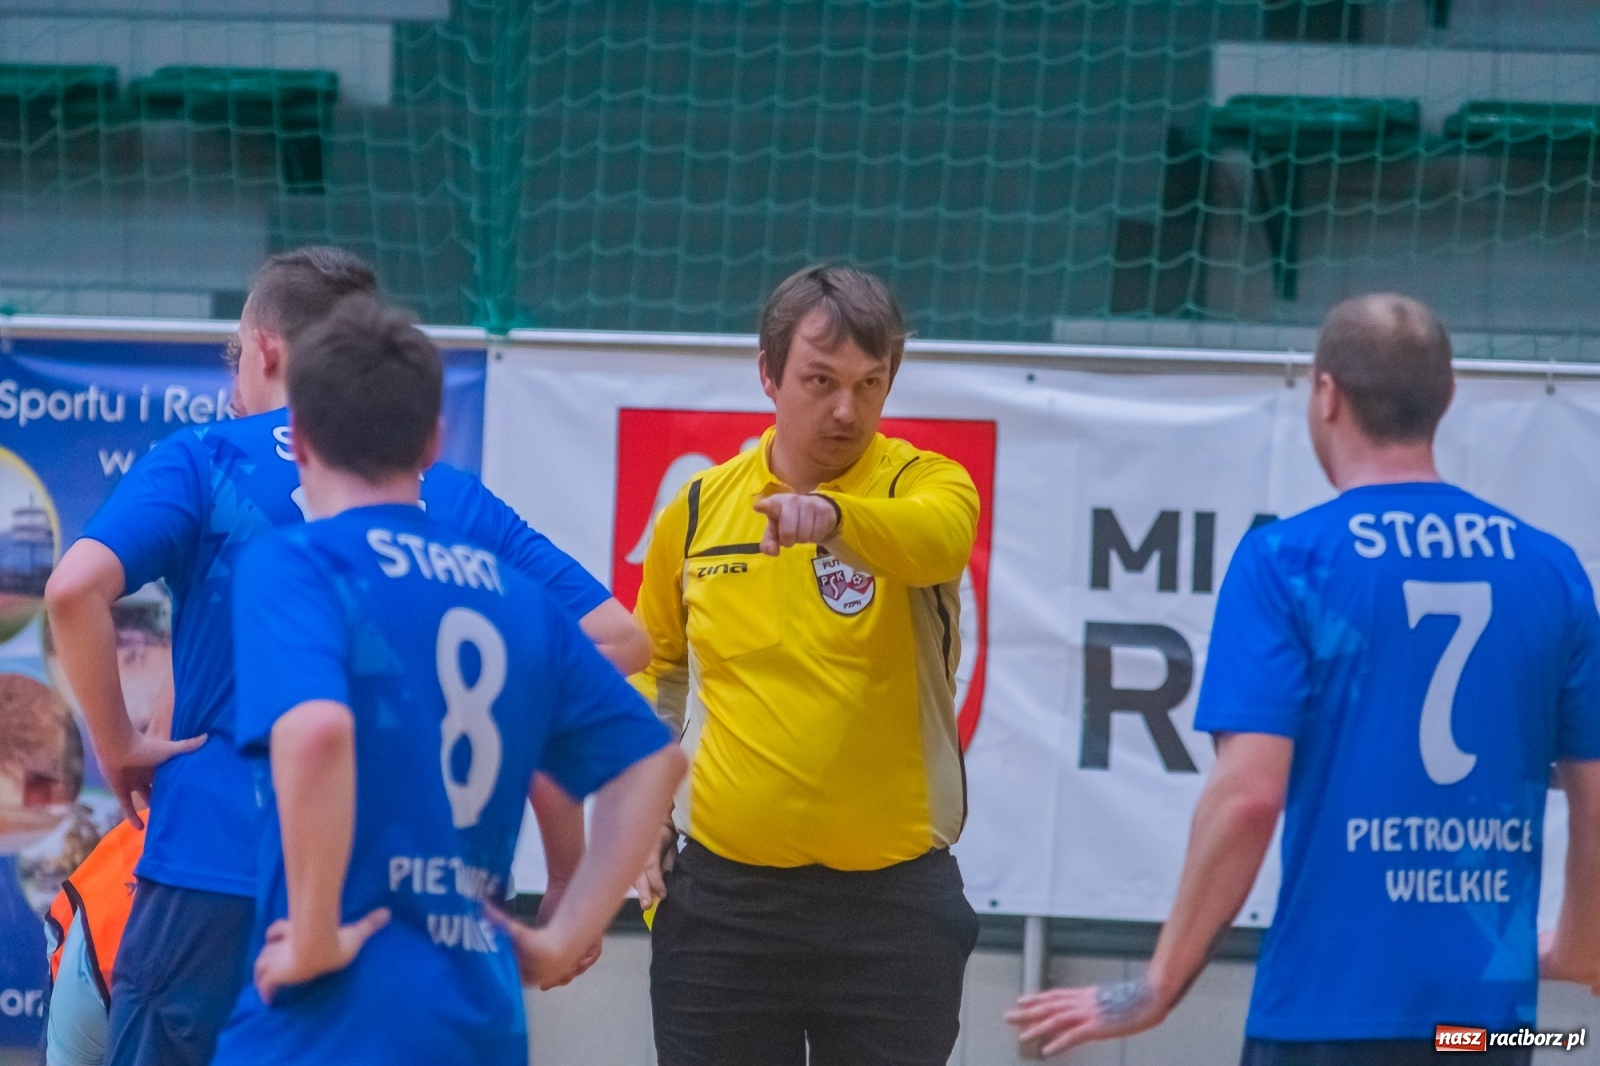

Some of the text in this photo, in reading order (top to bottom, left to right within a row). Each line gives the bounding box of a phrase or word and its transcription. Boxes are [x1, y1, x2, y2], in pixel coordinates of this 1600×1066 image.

[0, 379, 125, 427] Sportu
[139, 384, 149, 423] i
[366, 527, 504, 597] START
[1089, 507, 1281, 594] MI
[1348, 511, 1517, 560] START
[436, 606, 508, 829] 8
[1402, 580, 1493, 786] 7
[1385, 868, 1511, 903] WIELKIE
